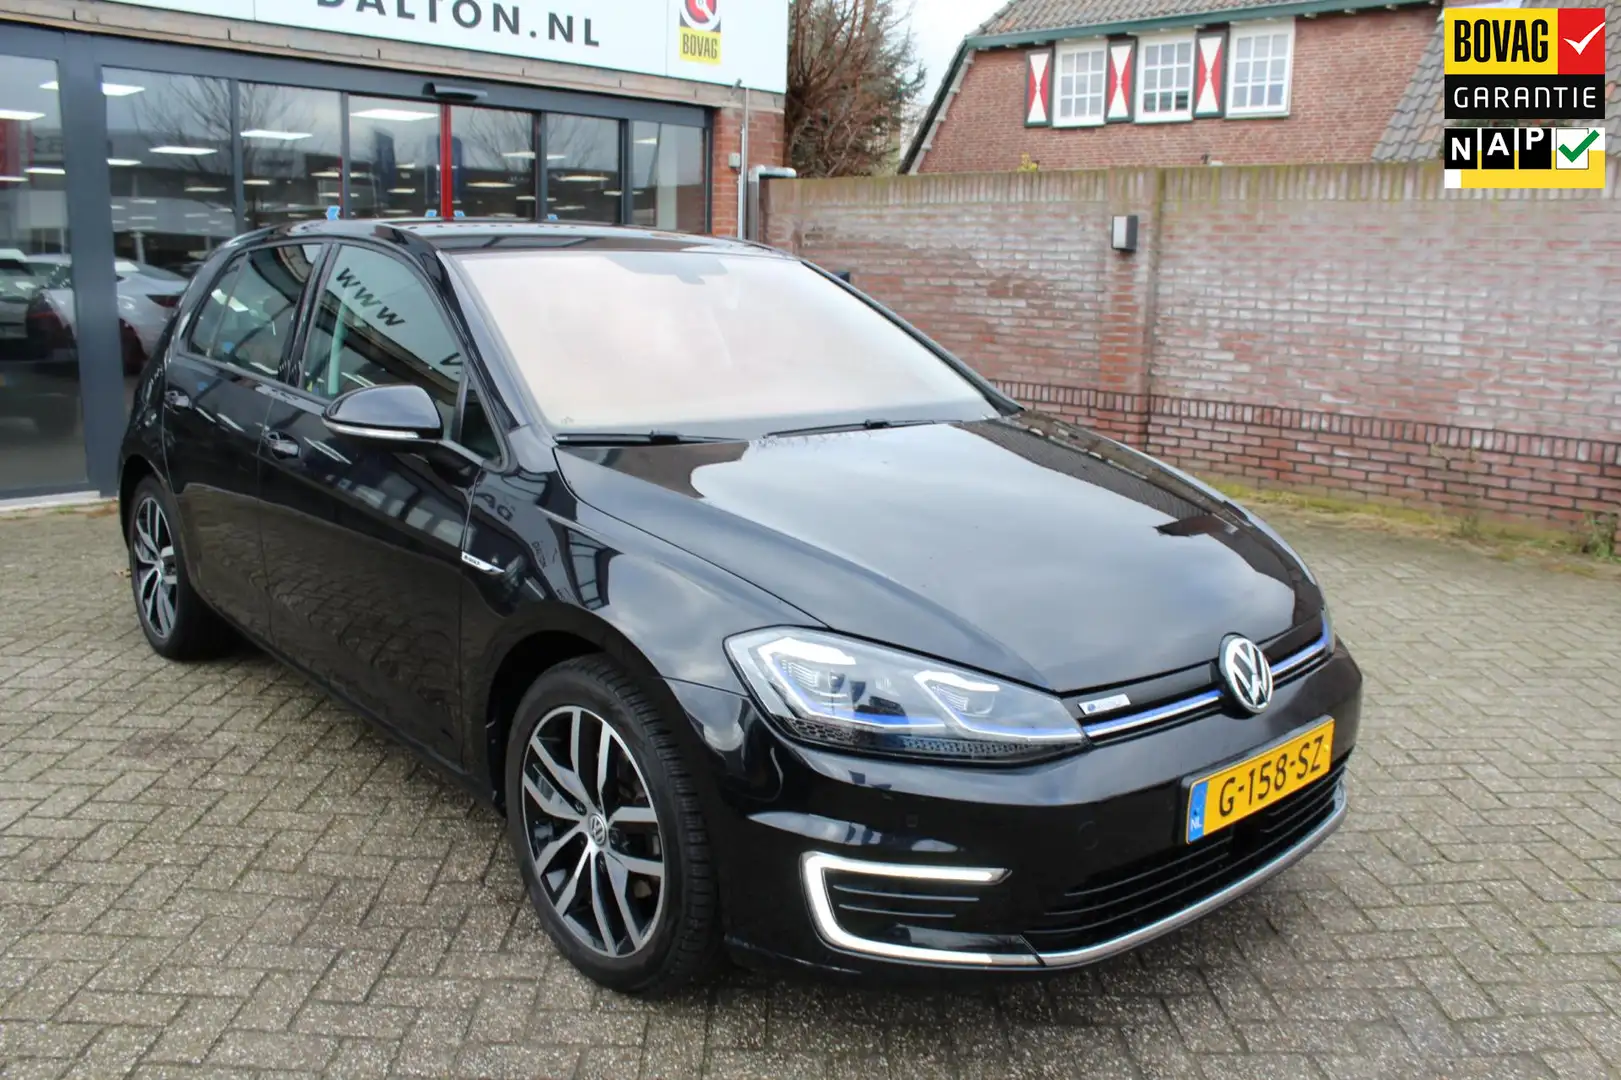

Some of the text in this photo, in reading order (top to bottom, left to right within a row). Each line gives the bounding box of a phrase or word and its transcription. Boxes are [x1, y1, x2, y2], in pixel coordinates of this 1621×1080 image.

[317, 0, 599, 47] ALTON.NL
[682, 33, 718, 60] BOVAG
[1219, 734, 1324, 817] G-158-SZ
